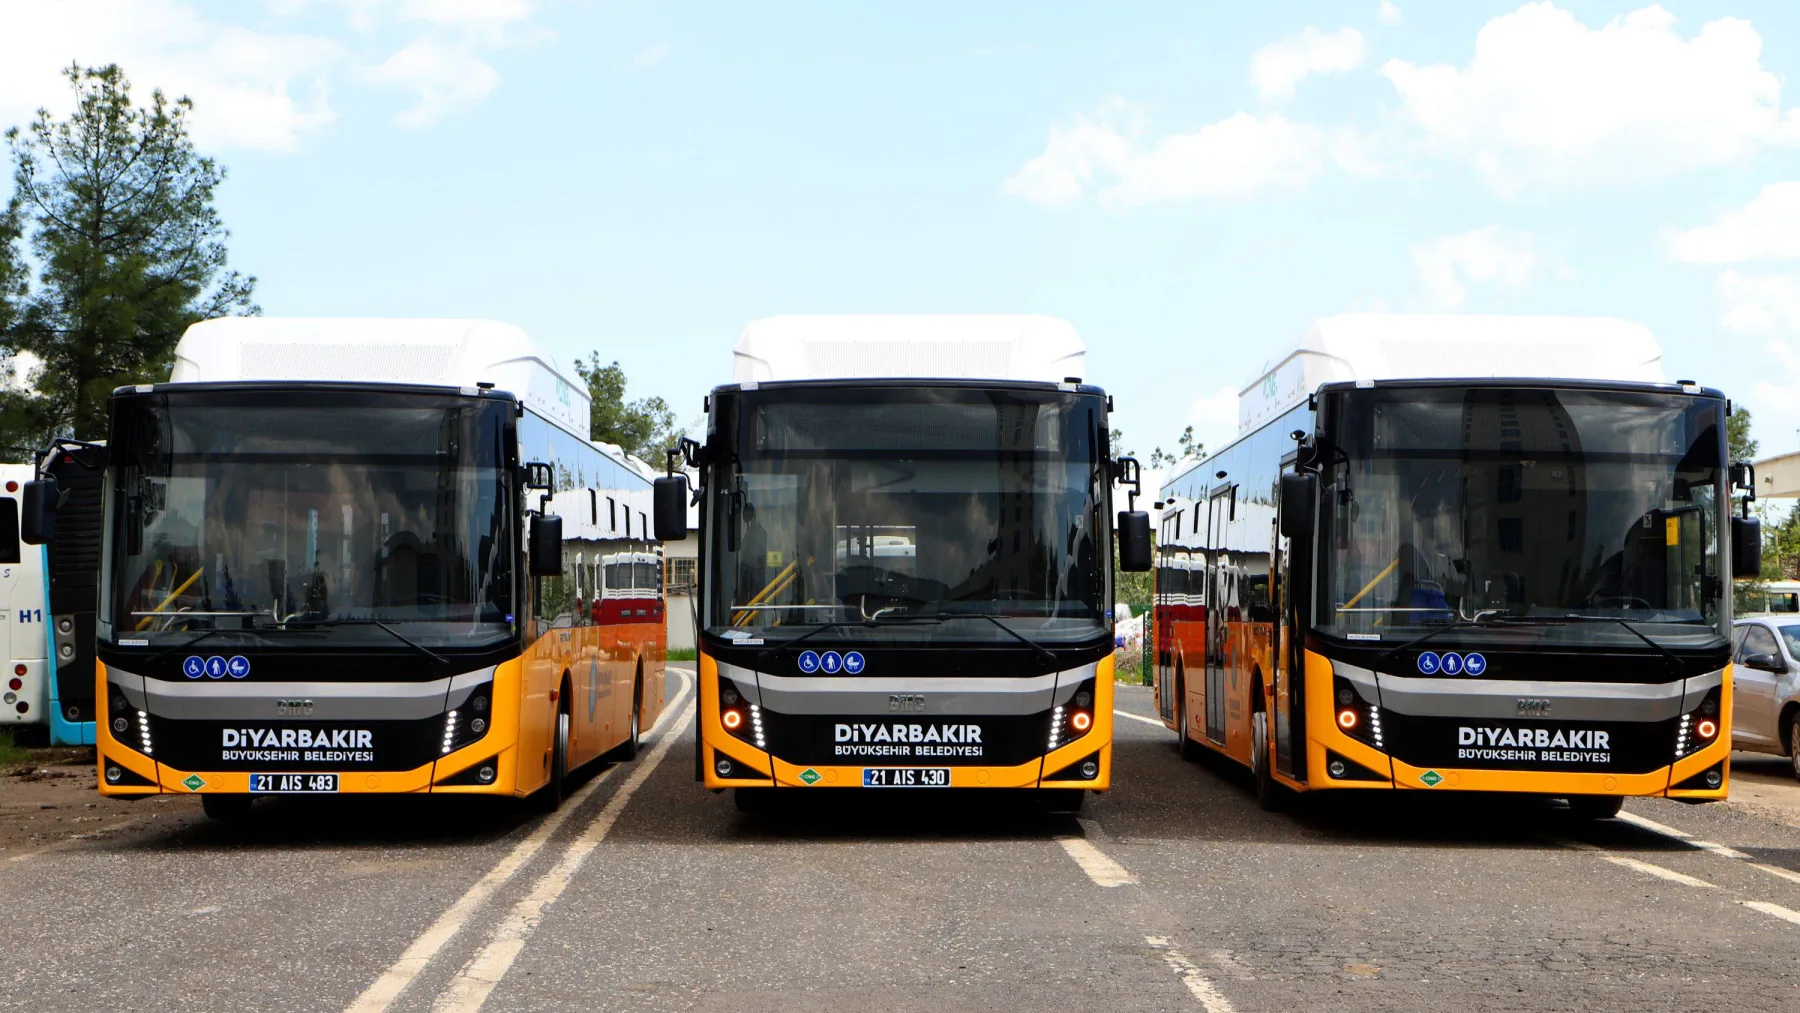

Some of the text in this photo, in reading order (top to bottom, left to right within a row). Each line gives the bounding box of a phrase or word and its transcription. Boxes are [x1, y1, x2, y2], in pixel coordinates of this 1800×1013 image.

[19, 609, 41, 623] H1
[257, 775, 272, 791] 21
[280, 775, 302, 791] AIS
[871, 769, 886, 785] 21
[893, 769, 915, 785] AIS
[921, 769, 945, 785] 430
